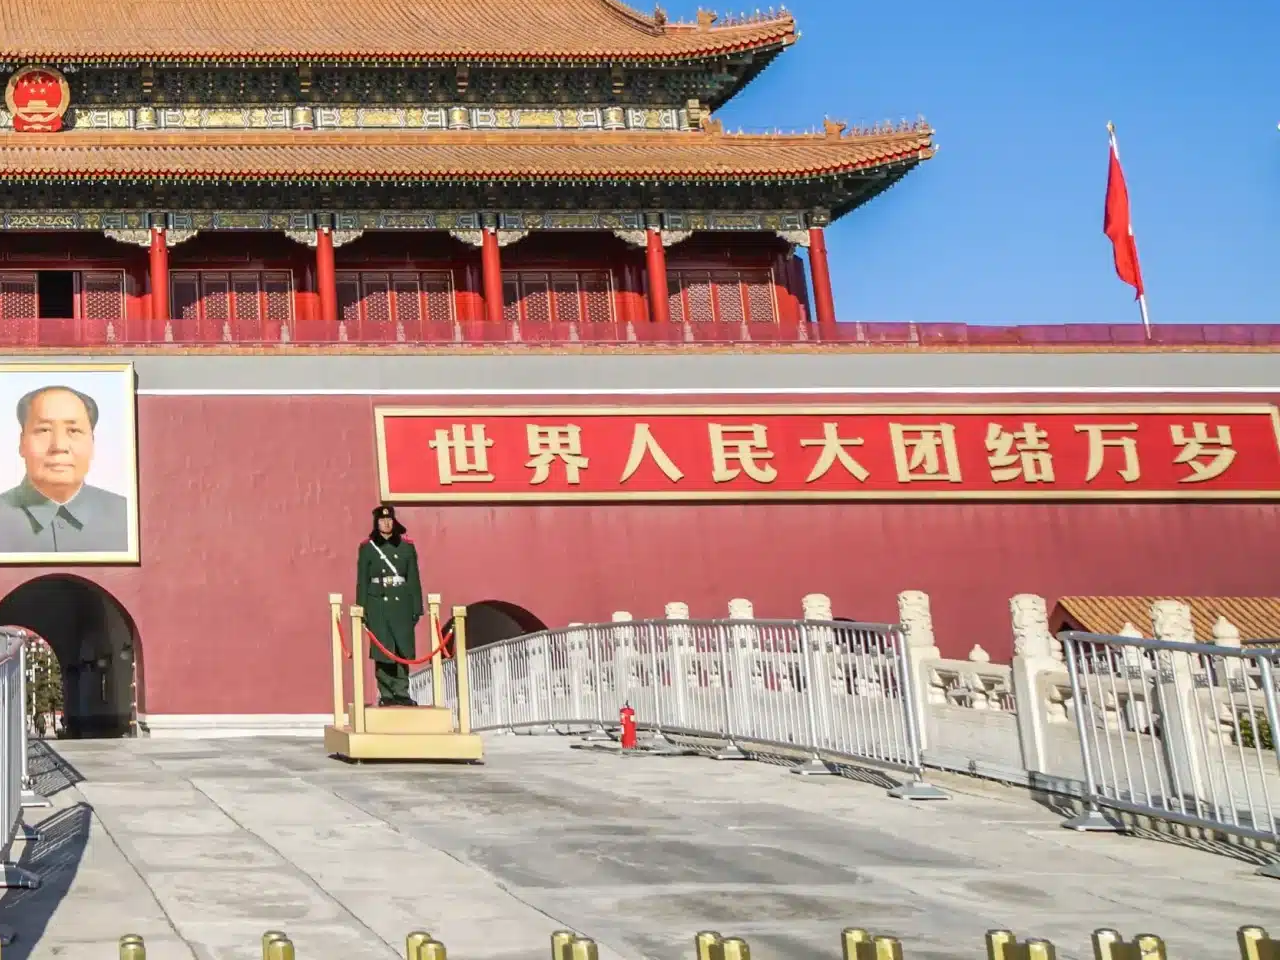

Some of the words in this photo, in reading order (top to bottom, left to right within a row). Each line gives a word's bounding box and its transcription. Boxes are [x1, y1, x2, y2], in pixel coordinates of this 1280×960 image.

[428, 422, 1237, 485] 世界人民大团结万岁
